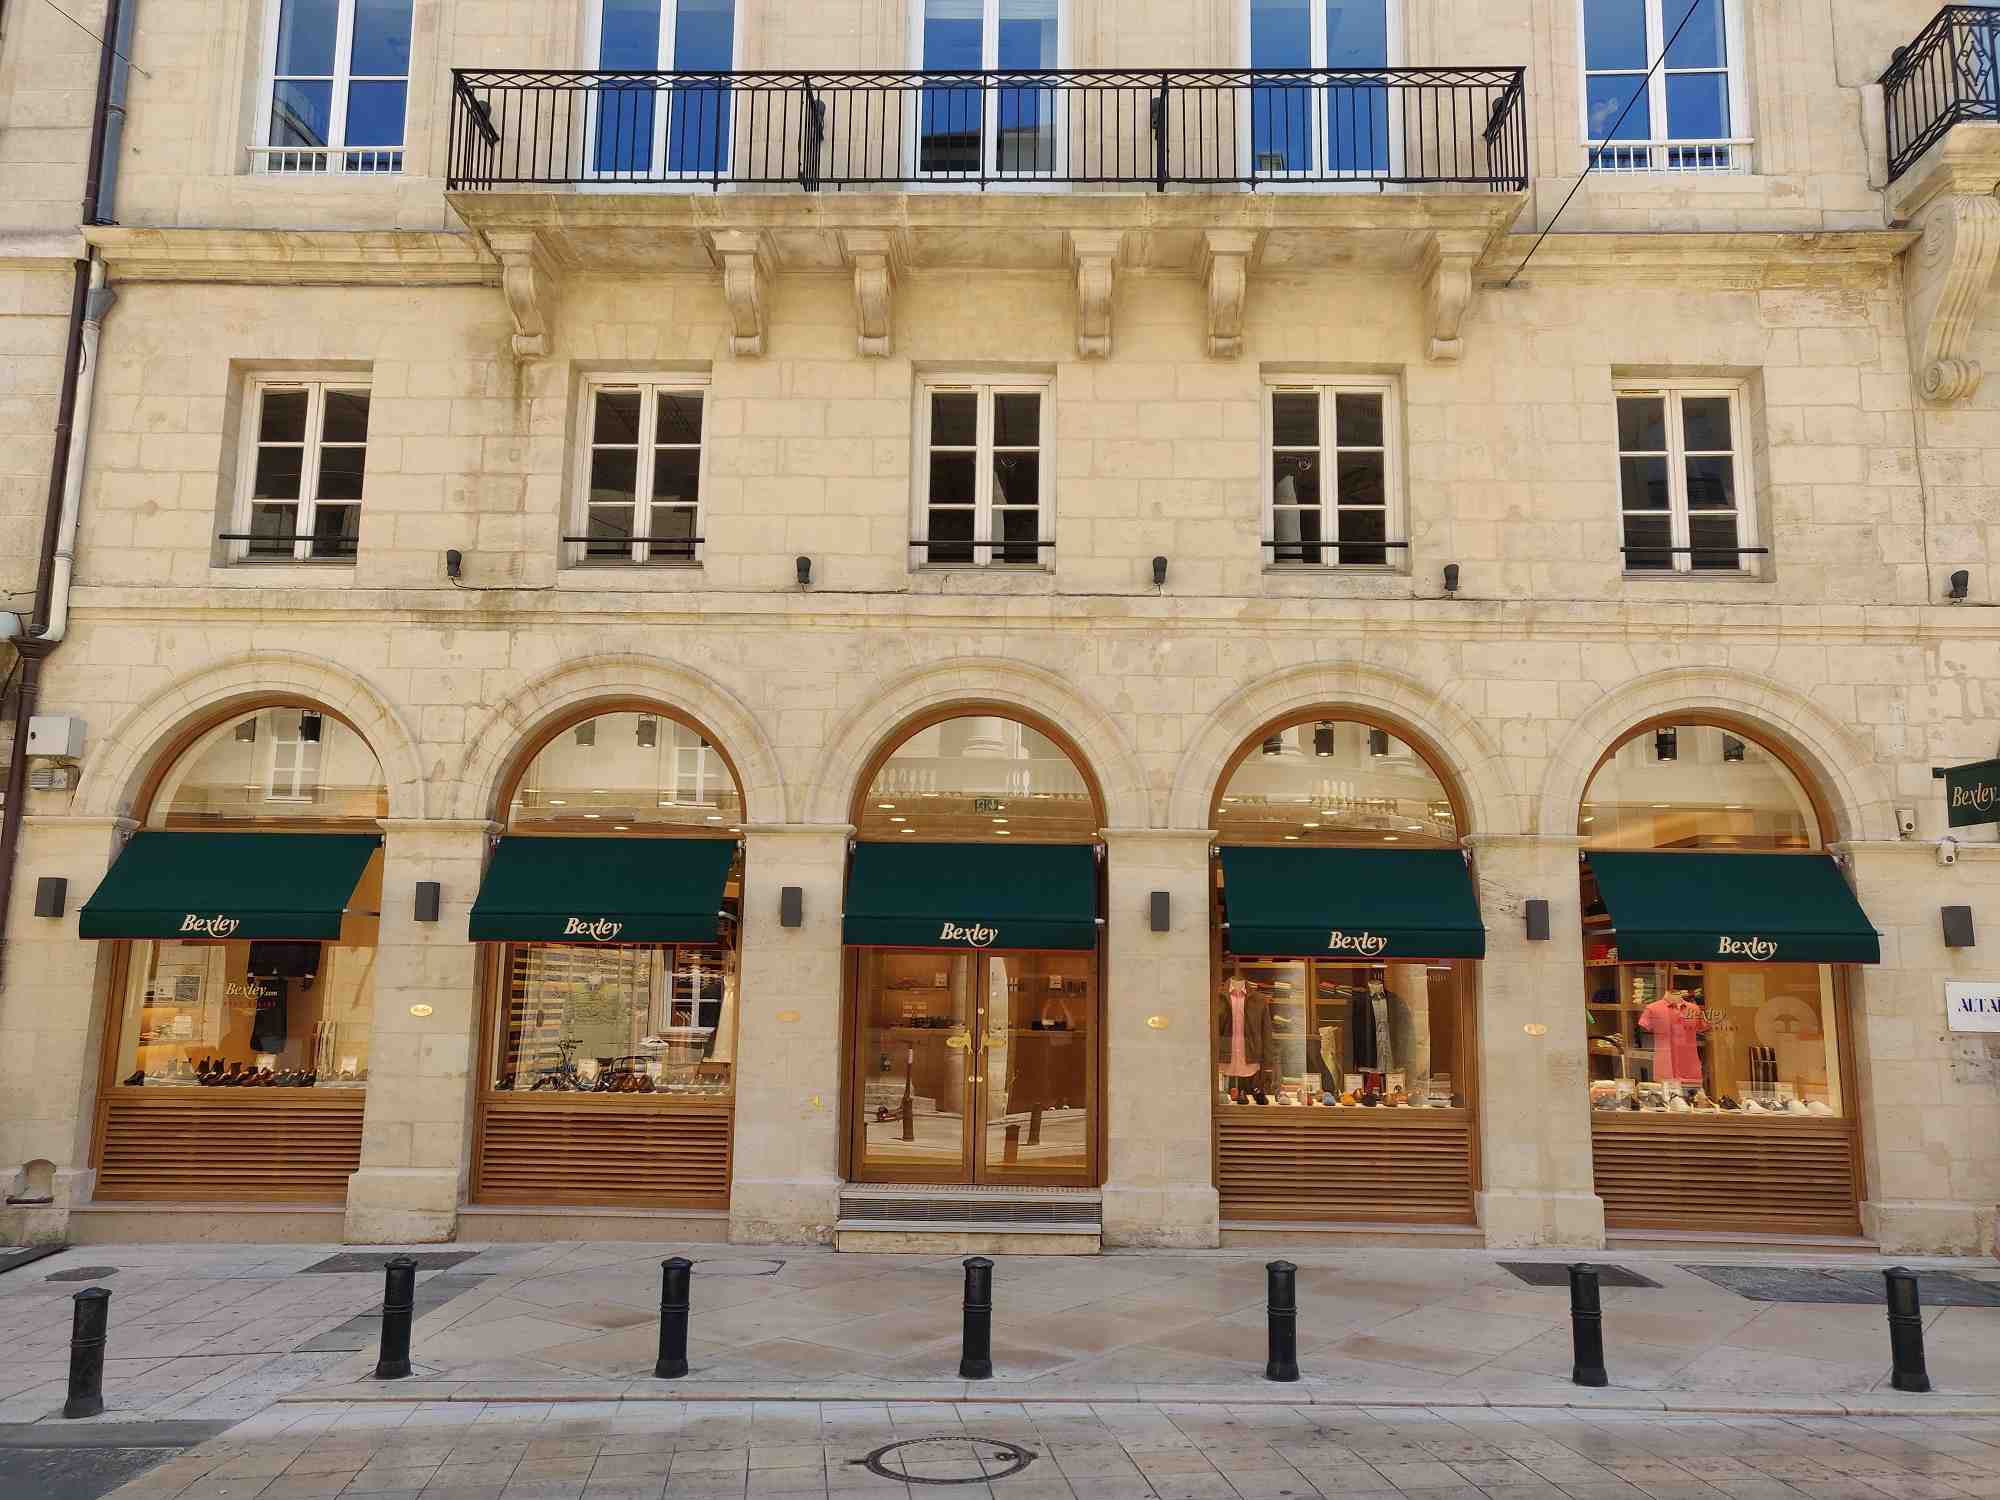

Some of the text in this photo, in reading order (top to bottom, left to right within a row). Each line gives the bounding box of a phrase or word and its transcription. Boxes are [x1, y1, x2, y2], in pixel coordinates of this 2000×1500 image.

[1951, 782, 1998, 811] Bexley
[179, 914, 240, 938] Bexley
[563, 917, 623, 941] Bexley
[940, 922, 999, 947] Bexley
[1328, 931, 1388, 956] Bexley
[1717, 936, 1778, 961] Bexley
[1958, 998, 2000, 1013] ALTA
